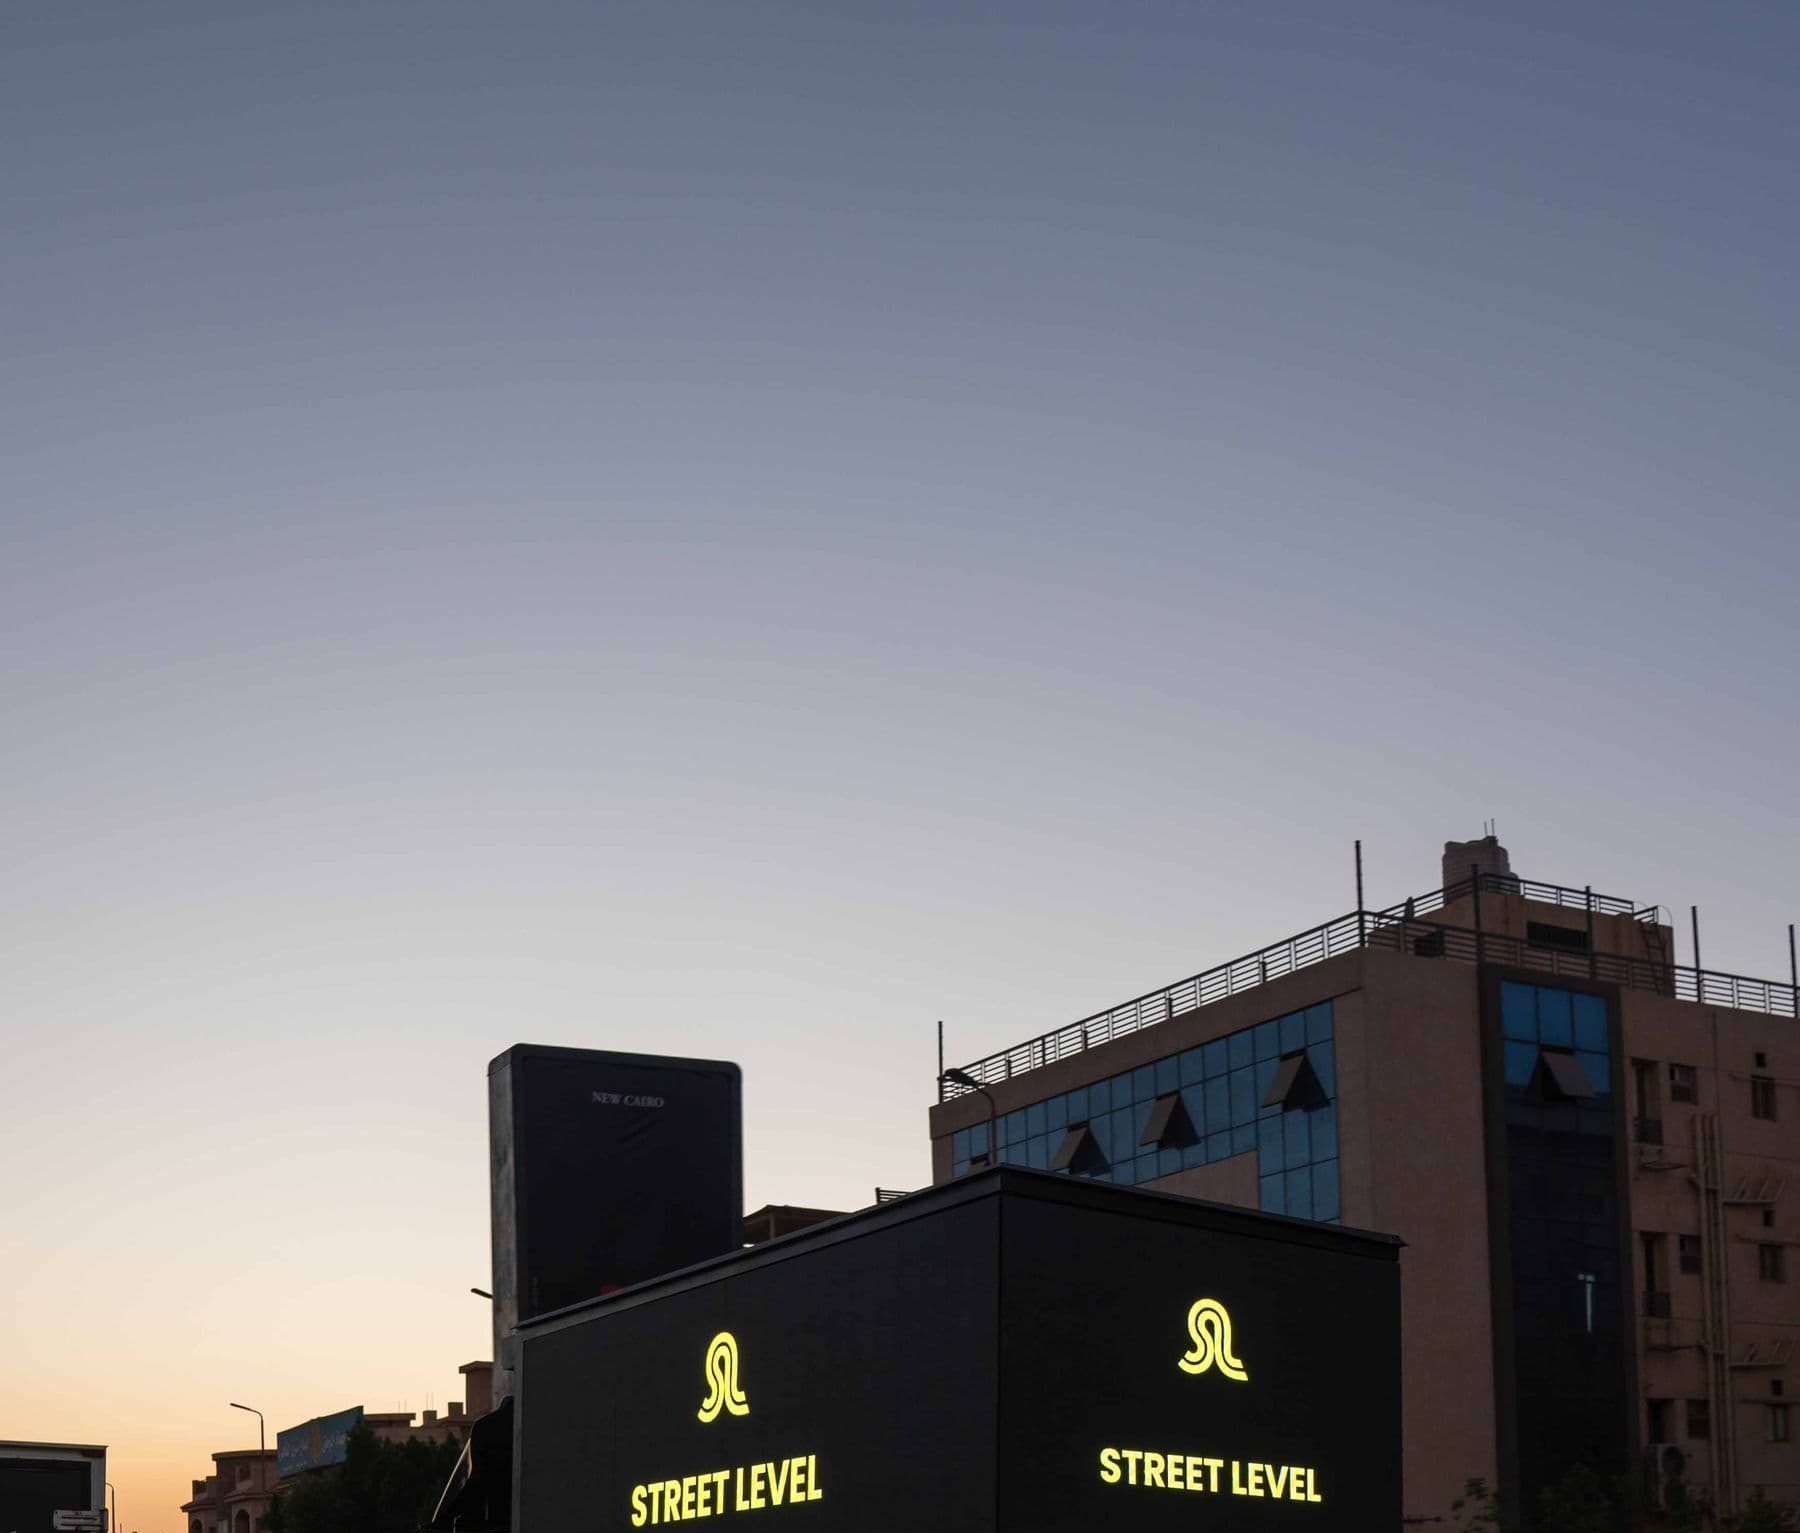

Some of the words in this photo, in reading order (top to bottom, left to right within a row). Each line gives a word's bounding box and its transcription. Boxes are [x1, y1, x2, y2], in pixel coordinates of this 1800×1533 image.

[592, 1091, 623, 1104] NEW
[624, 1096, 665, 1108] CAIRO
[631, 1469, 731, 1527] STREET
[735, 1454, 823, 1512] LEVEL
[1099, 1447, 1224, 1493] STREET
[1231, 1460, 1322, 1503] LEVEL
